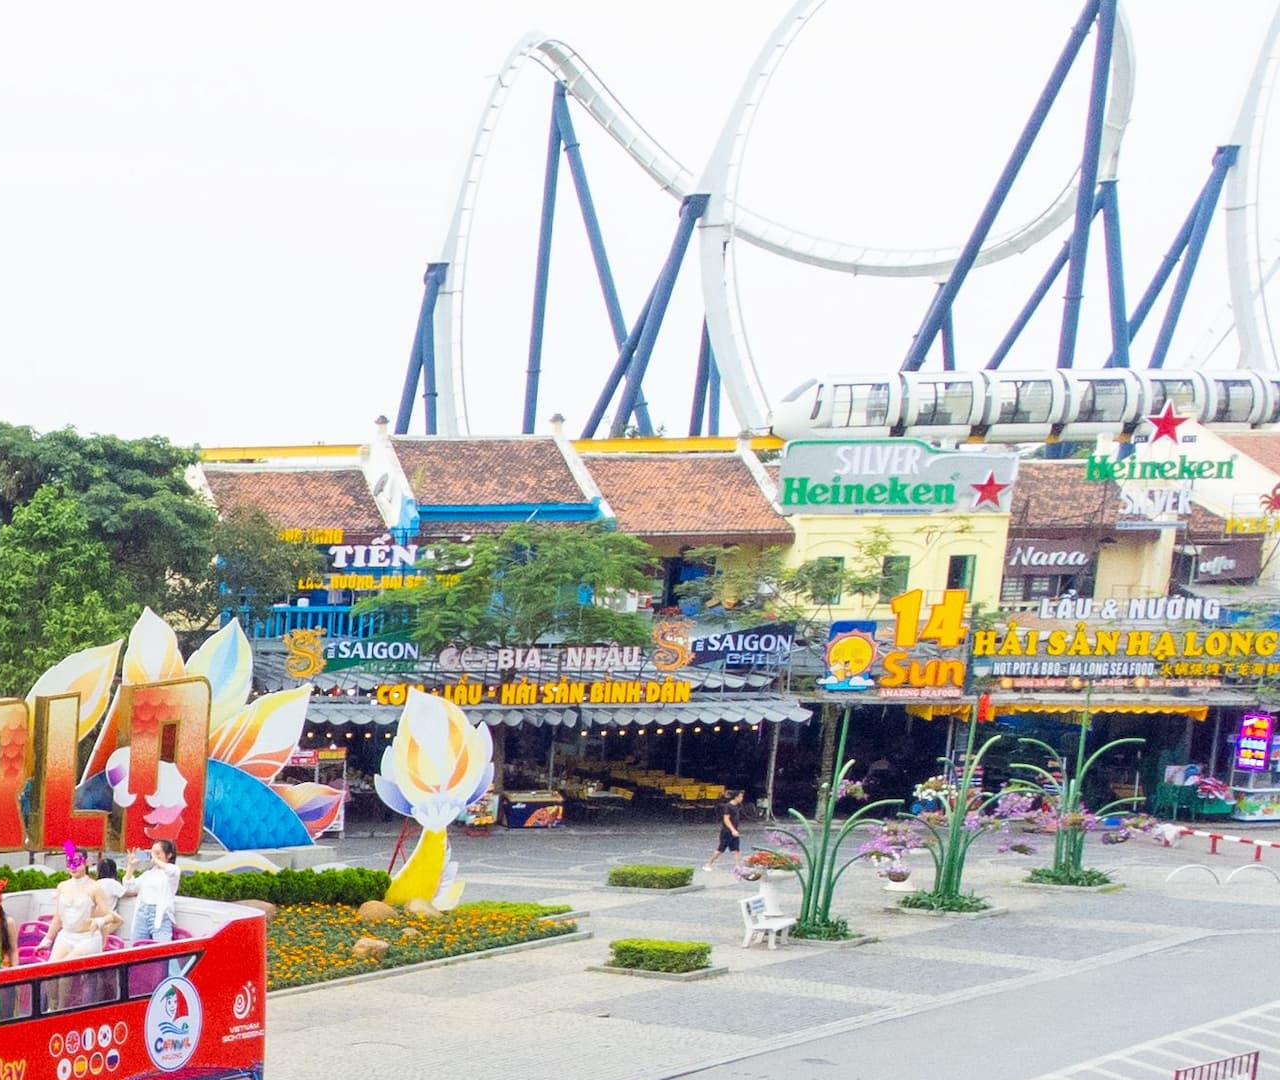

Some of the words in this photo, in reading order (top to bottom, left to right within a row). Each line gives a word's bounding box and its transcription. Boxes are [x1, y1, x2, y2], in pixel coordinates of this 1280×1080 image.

[834, 445, 920, 475] SILVER
[1085, 455, 1235, 481] Heineken
[783, 475, 957, 506] Heineken
[329, 533, 418, 568] TIẾN
[1009, 546, 1089, 567] Nana
[891, 588, 968, 648] 14
[1101, 599, 1119, 619] &
[338, 640, 420, 660] SAIGON
[707, 633, 793, 652] SAIGON
[973, 621, 1039, 657] HẢI
[1046, 621, 1121, 657] SẢN
[1126, 630, 1177, 661] HẠ
[1183, 630, 1280, 657] LONG
[498, 648, 541, 669] BIA
[879, 651, 965, 688] Sun
[993, 661, 1013, 675] HOT
[1013, 661, 1032, 675] POT
[1041, 661, 1061, 676] BBQ
[1083, 661, 1109, 675] LONG
[501, 676, 538, 704] HẢI
[541, 676, 585, 704] SẢN
[590, 676, 641, 704] BÌNH
[645, 676, 691, 703] DÂN
